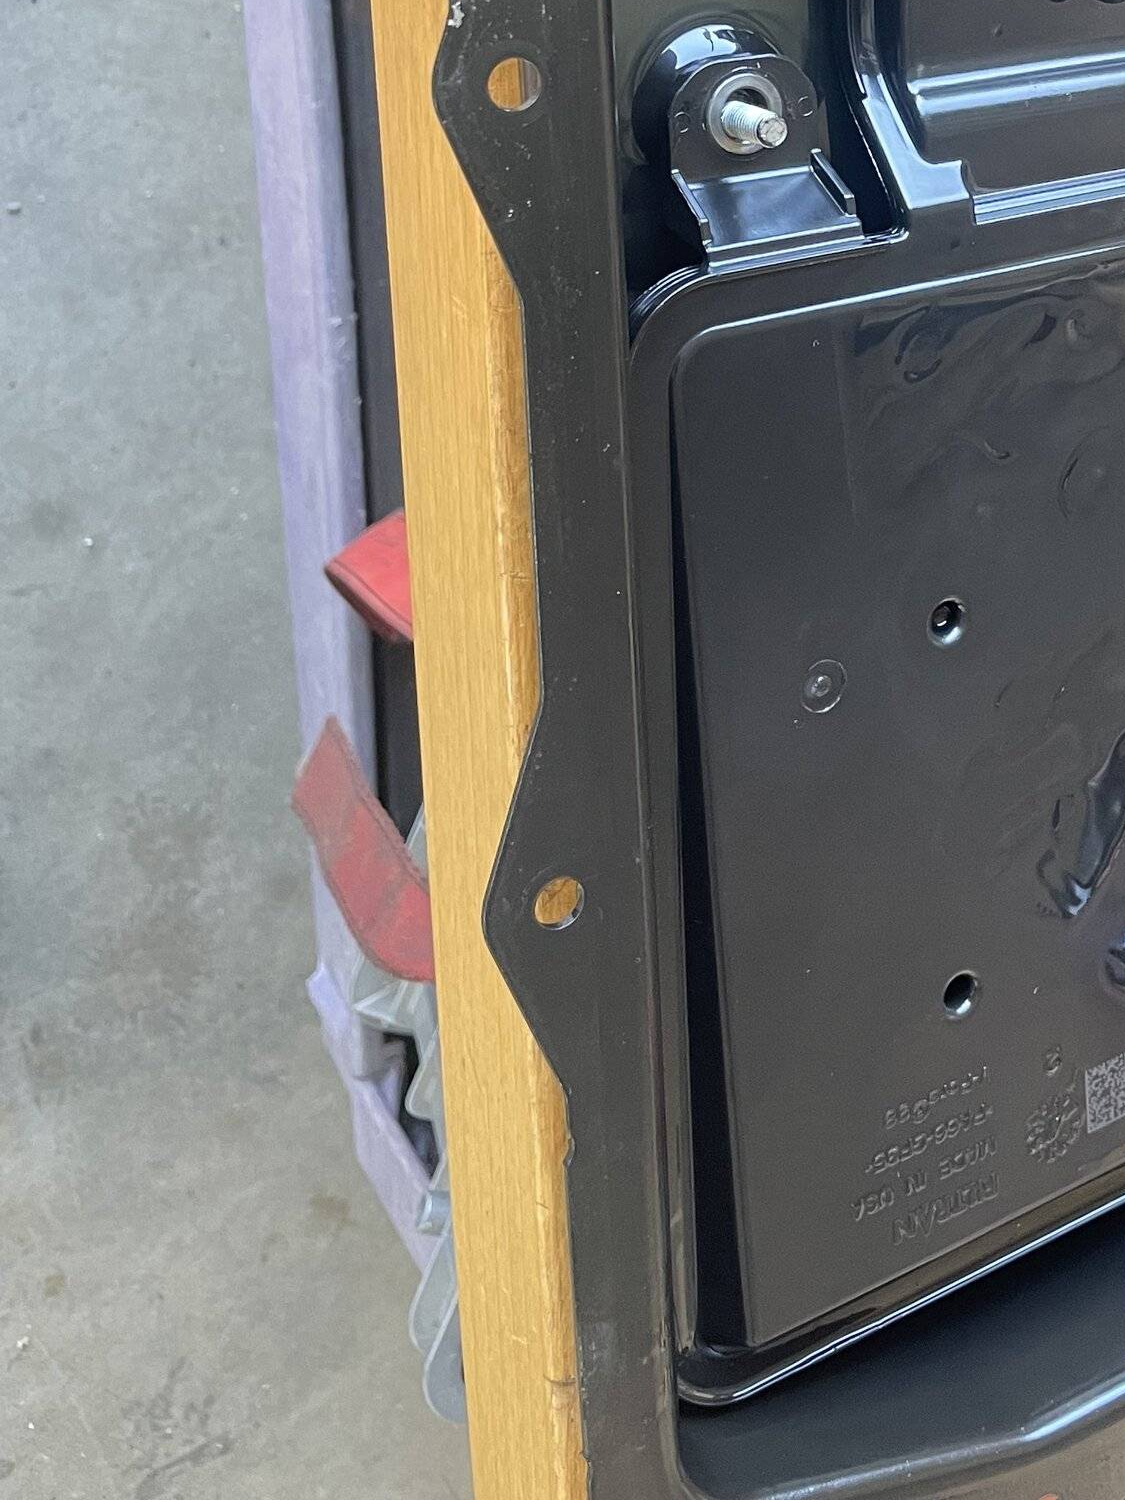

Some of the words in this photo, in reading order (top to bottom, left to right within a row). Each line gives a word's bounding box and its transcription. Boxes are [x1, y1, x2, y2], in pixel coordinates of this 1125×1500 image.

[937, 1135, 997, 1180] MADE
[905, 1170, 928, 1197] IN
[851, 1186, 895, 1222] USA
